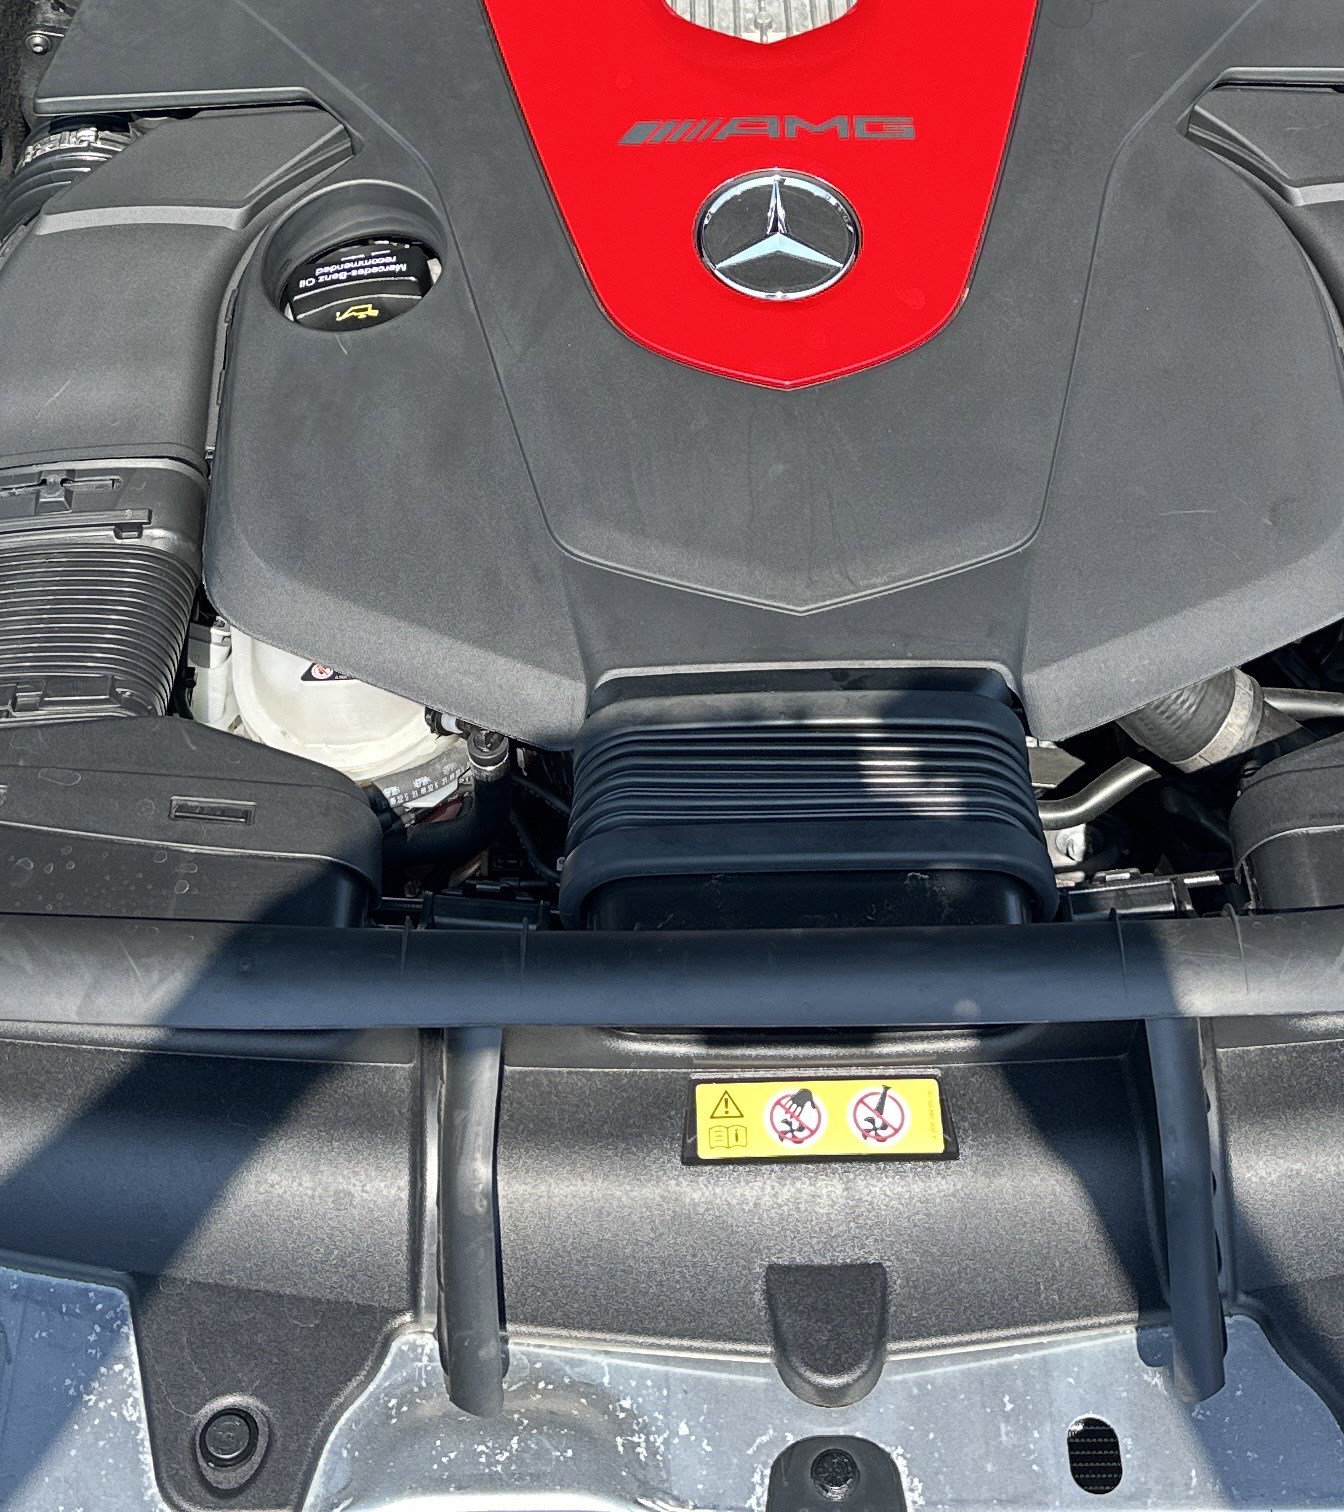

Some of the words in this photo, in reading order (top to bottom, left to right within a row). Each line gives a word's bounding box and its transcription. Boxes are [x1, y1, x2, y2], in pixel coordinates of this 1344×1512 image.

[713, 115, 916, 140] AMG
[315, 256, 397, 275] recommended
[317, 263, 407, 283] Mercedes-Benz
[299, 277, 316, 289] Oil
